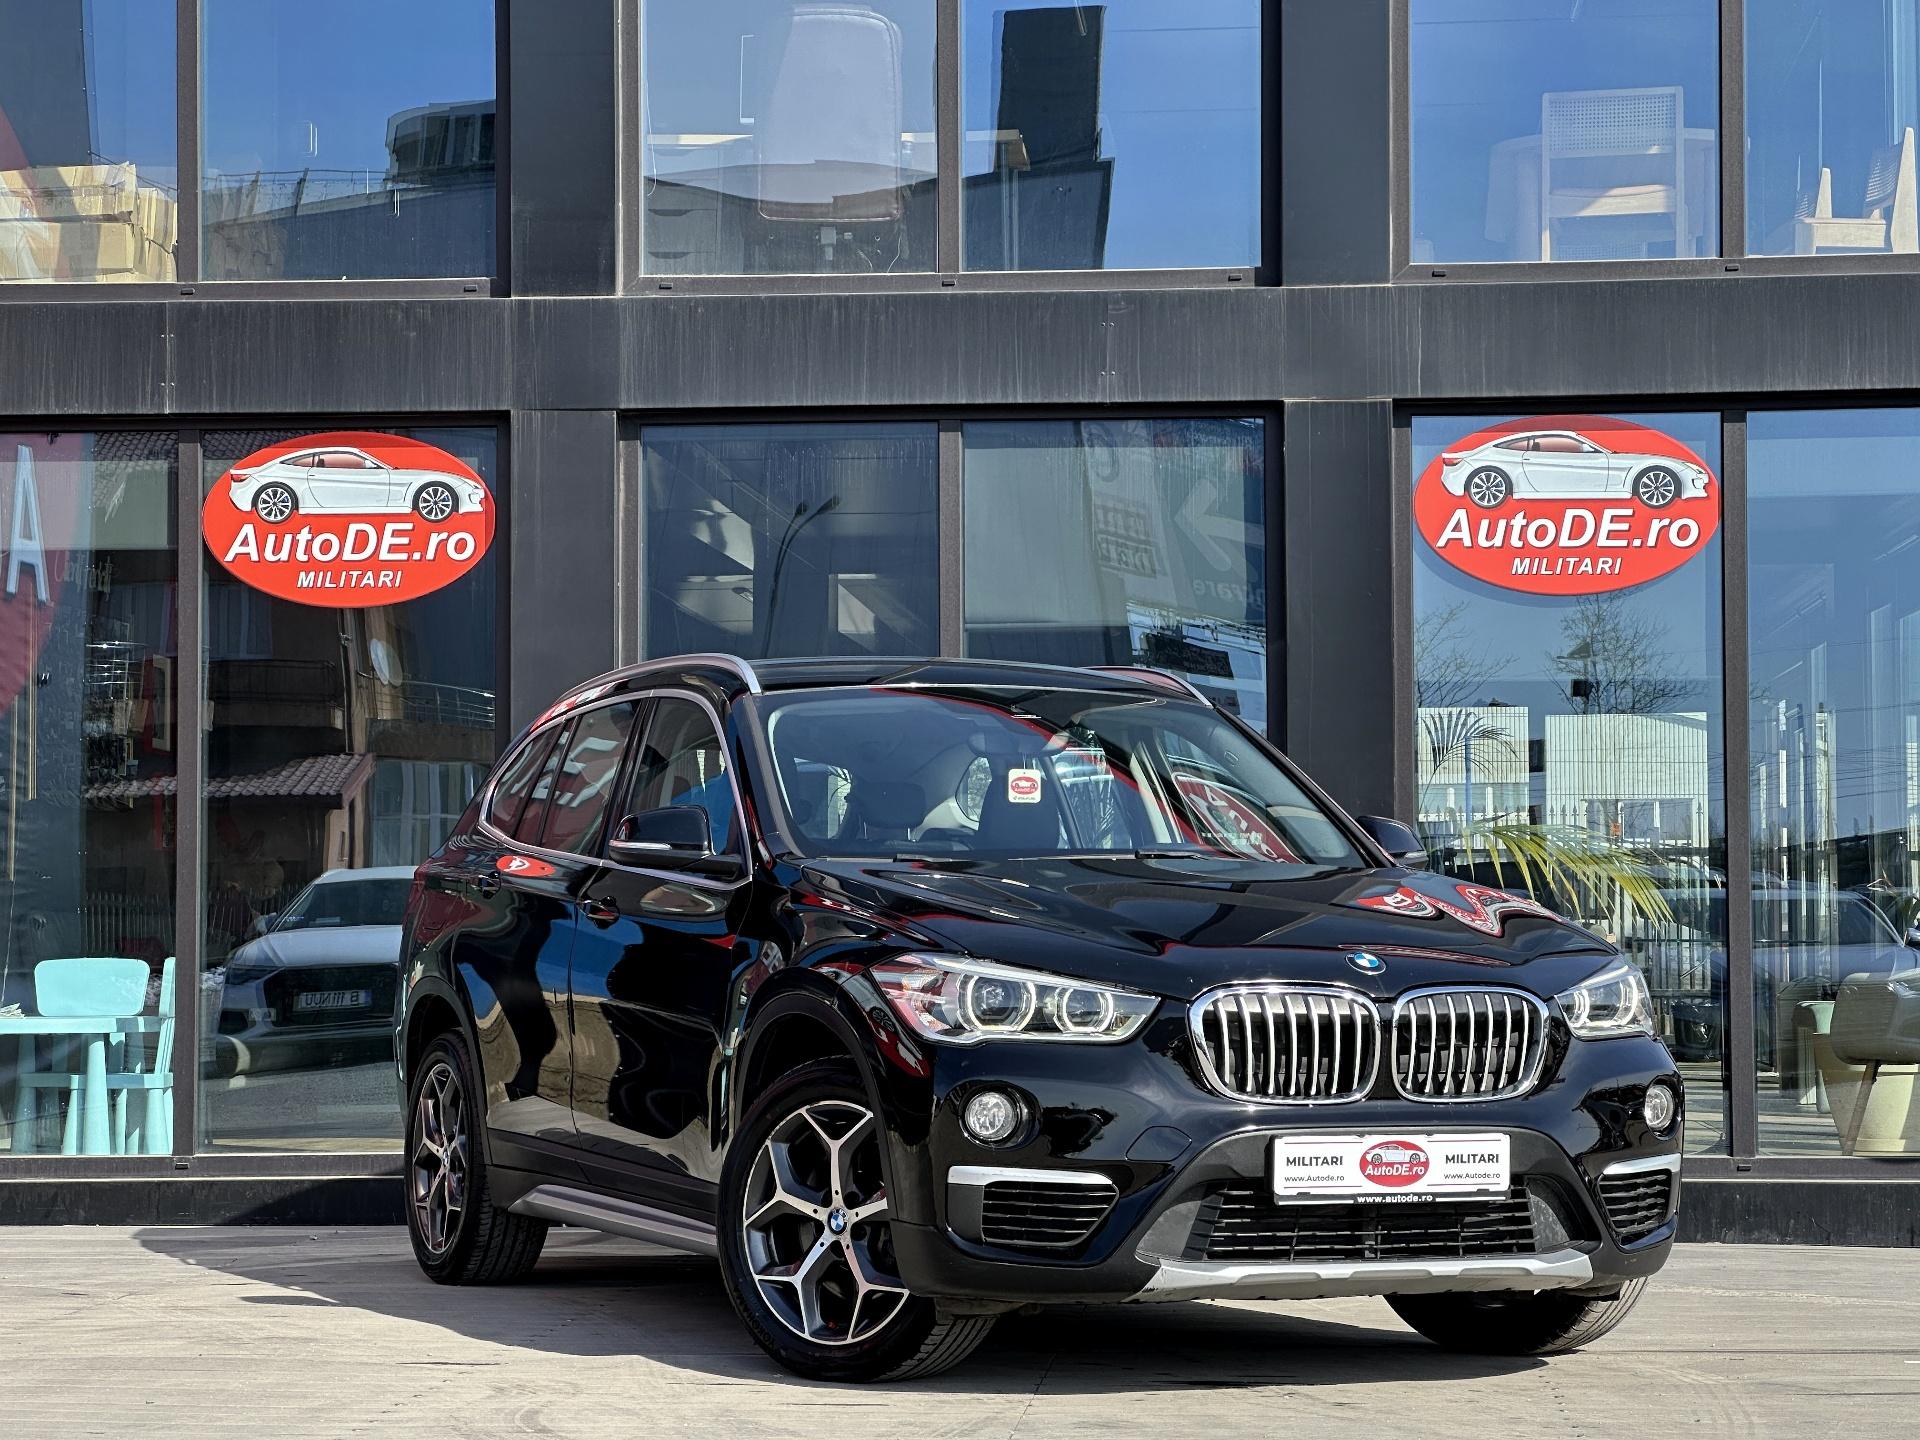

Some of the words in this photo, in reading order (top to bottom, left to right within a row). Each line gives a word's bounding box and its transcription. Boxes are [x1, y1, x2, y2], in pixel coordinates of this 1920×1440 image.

[1435, 508, 1700, 548] AutoDE.ro
[223, 522, 476, 563] AutoDE.ro
[1511, 557, 1622, 576] MILITARI
[297, 570, 402, 589] MILITARI
[1285, 1155, 1343, 1167] MILITARI
[1445, 1153, 1500, 1164] MILITARI
[1364, 1163, 1426, 1177] AutoDE.ro
[1443, 1172, 1501, 1180] www.Autode.ro
[1284, 1174, 1345, 1182] www.Autode.ro
[1357, 1194, 1433, 1204] www.autode.ro
